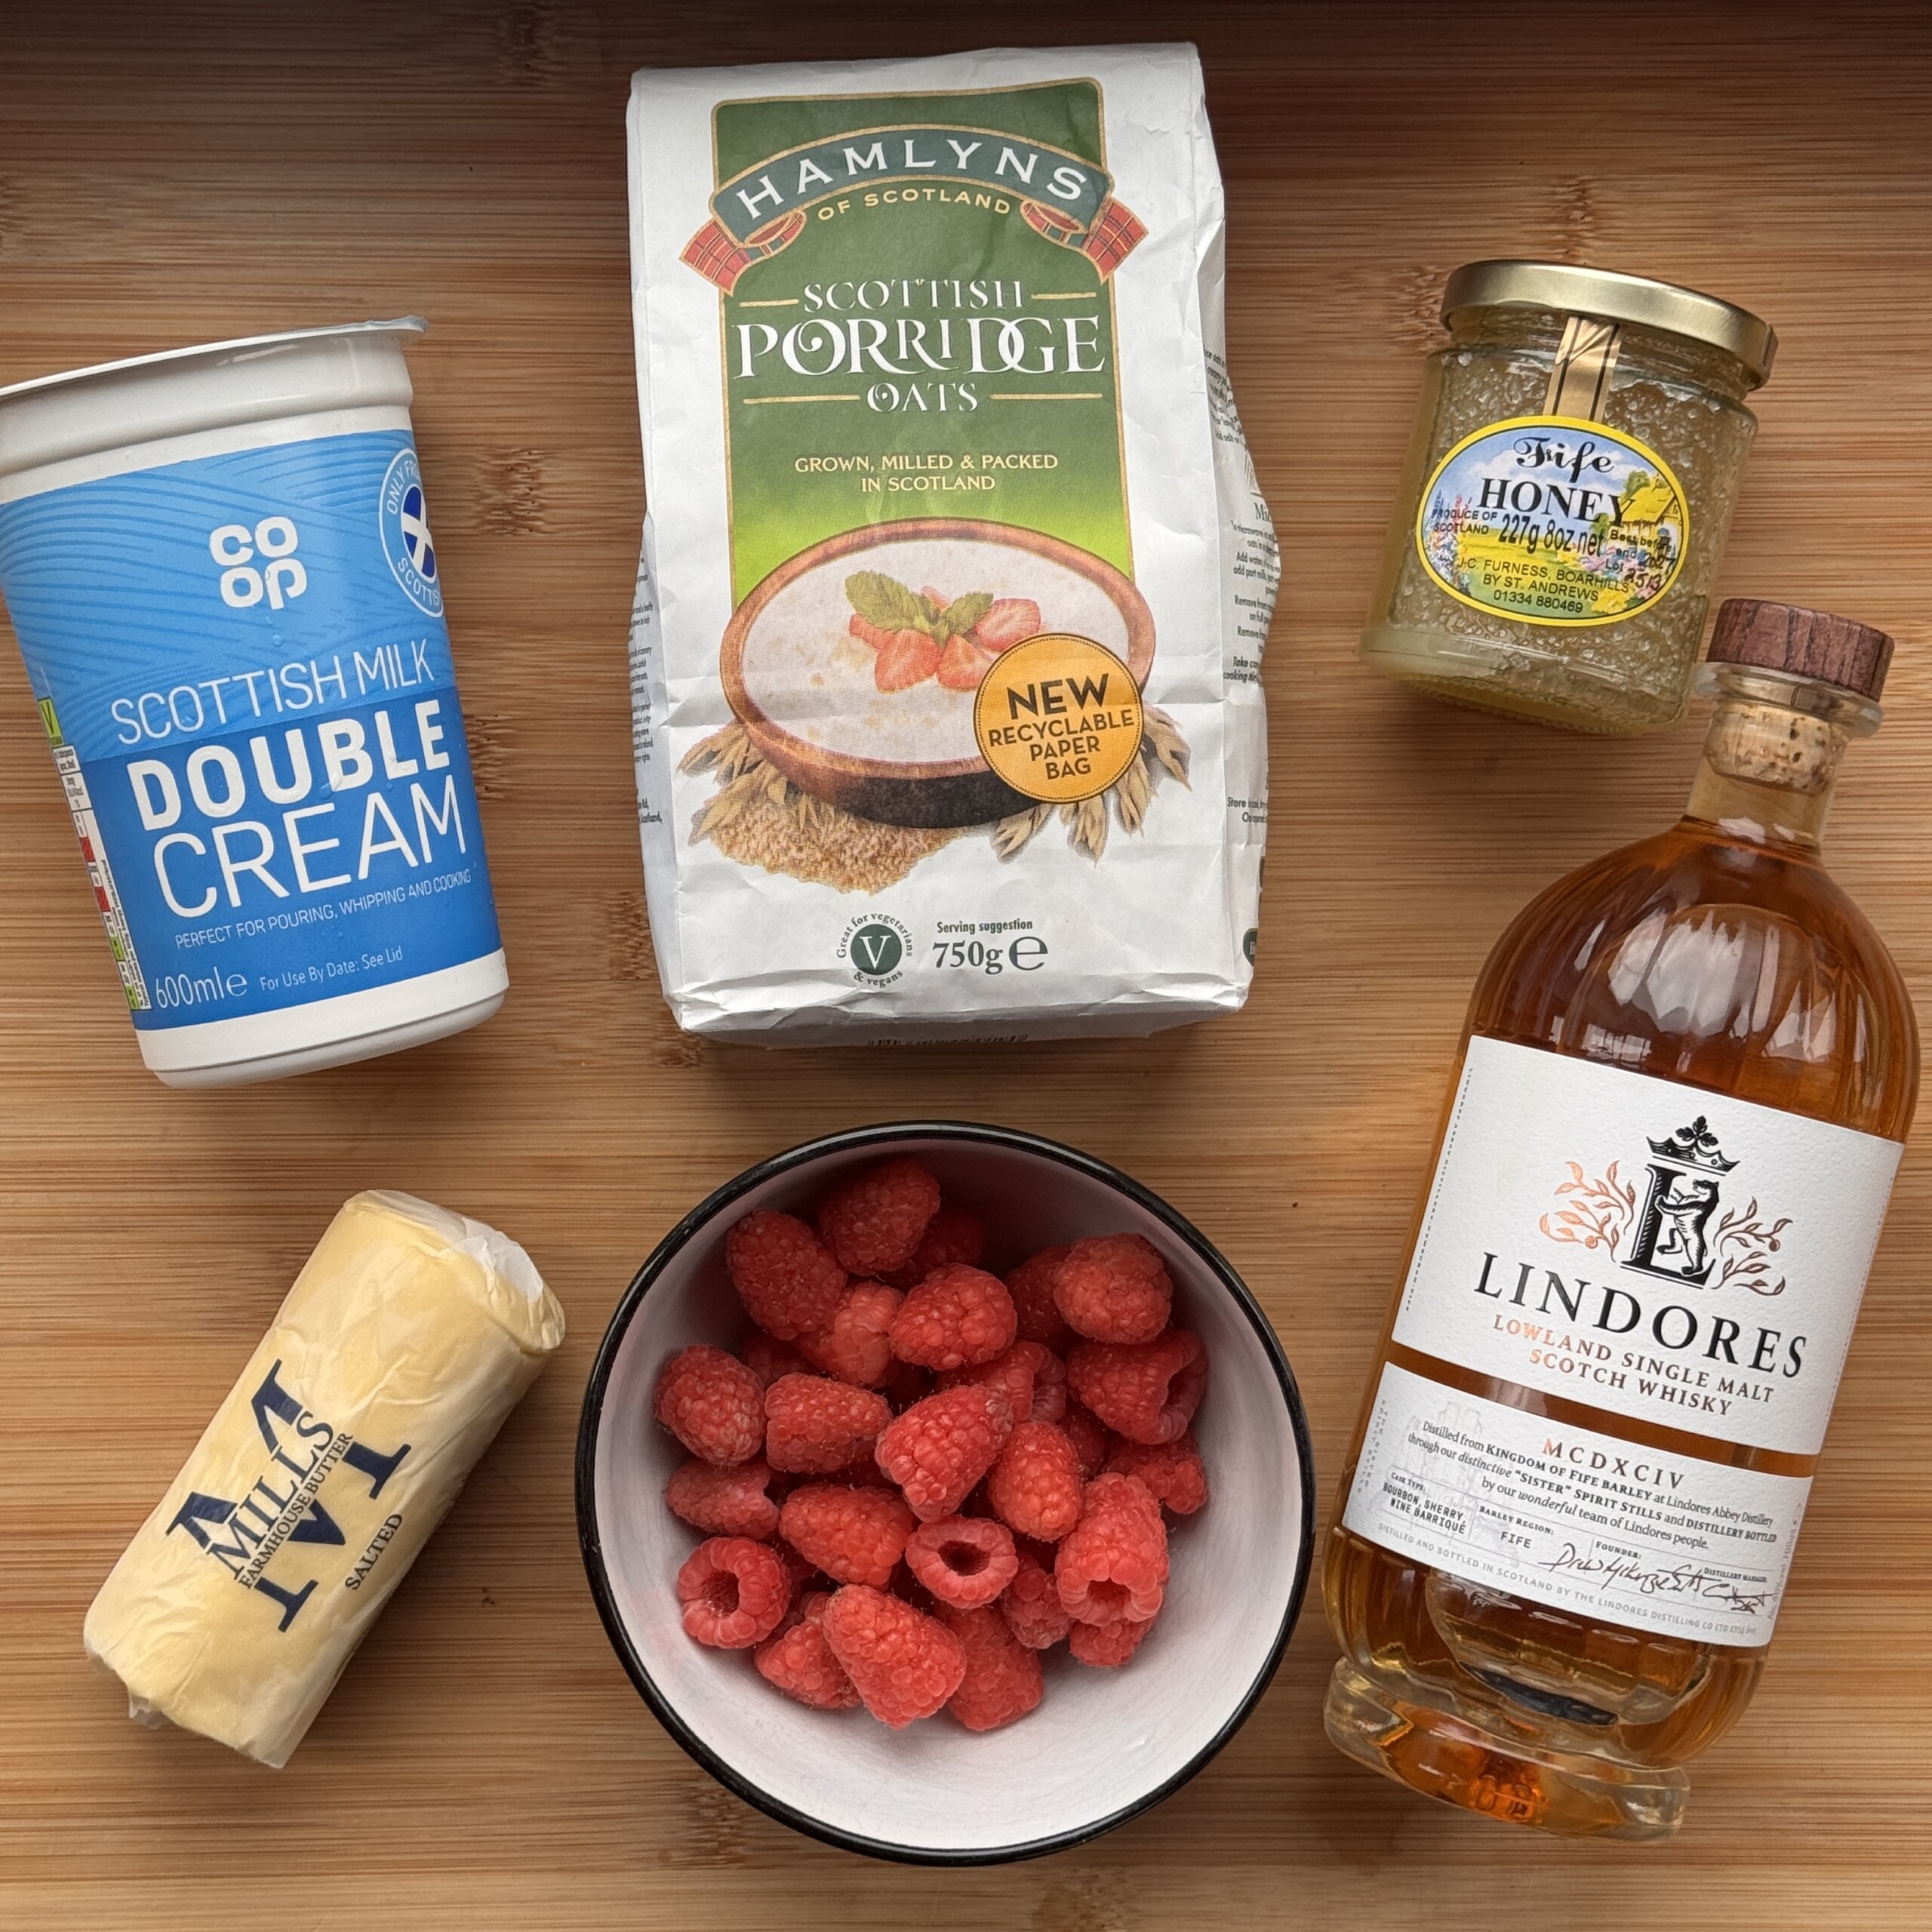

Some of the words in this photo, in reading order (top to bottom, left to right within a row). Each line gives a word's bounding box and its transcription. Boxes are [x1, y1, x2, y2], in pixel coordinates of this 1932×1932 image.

[736, 139, 1089, 220] HAMLYNS
[817, 200, 851, 221] OF
[864, 189, 1011, 215] SCOTLAND
[803, 278, 1024, 312] SCOTTISH
[733, 315, 1106, 379] PORRIDGE
[866, 382, 980, 413] OATS
[795, 456, 874, 474] GROWN,
[881, 454, 953, 470] MILLED
[960, 454, 974, 469] &
[981, 454, 1058, 470] PACKED
[1513, 435, 1615, 483] Fife
[386, 466, 405, 515] ONLY
[405, 460, 420, 481] FRO
[861, 476, 881, 492] IN
[887, 475, 996, 492] SCOTLAND
[1477, 477, 1636, 528] HONEY
[1432, 508, 1479, 521] PRODUCE
[1482, 510, 1497, 521] OF
[1434, 522, 1489, 535] SCOTLAND
[1498, 513, 1540, 554] 227g
[1543, 523, 1574, 552] 8oz
[1575, 528, 1605, 558] net
[1610, 529, 1638, 543] Best
[1616, 548, 1637, 558] end
[1483, 559, 1550, 580] FURNESS,
[1556, 569, 1630, 593] BOARHILLS
[1606, 558, 1624, 572] Lot
[1482, 574, 1500, 586] BY
[1504, 577, 1525, 590] ST.
[1528, 580, 1599, 602] ANDREWS
[1494, 589, 1532, 605] 01334
[1536, 593, 1583, 614] 880469
[1223, 669, 1247, 684] cooking
[1233, 656, 1248, 668] Take
[111, 655, 346, 745] SCOTTISH
[354, 638, 435, 695] MILK
[1007, 672, 1109, 720] NEW
[988, 709, 1134, 747] RECYCLABLE
[127, 700, 450, 831] DOUBLE
[1029, 735, 1101, 761] PAPER
[1045, 758, 1091, 780] BAG
[1227, 797, 1246, 808] Store
[153, 774, 466, 918] CREAM
[175, 926, 232, 950] PERFECT
[236, 919, 266, 939] FOR
[269, 904, 338, 930] POURING,
[339, 887, 406, 915] WHIPPING
[408, 879, 432, 899] AND
[433, 869, 472, 894] COOKING
[937, 921, 975, 934] Serving
[978, 918, 1033, 934] suggestion
[836, 926, 853, 958] Great
[851, 914, 869, 928] for
[870, 913, 912, 957] vegetarians
[859, 934, 892, 971] V
[260, 976, 279, 992] For
[282, 971, 305, 987] Use
[309, 966, 325, 984] By
[327, 958, 358, 980] Date:
[361, 952, 383, 970] See
[384, 946, 403, 964] Lid
[933, 940, 1003, 974] 750g
[853, 971, 863, 983] &
[867, 970, 903, 988] vegans
[1474, 1251, 1807, 1380] LINDORES
[1493, 1313, 1612, 1361] LOWLAND
[1621, 1352, 1710, 1389] SINGLE
[1717, 1377, 1775, 1404] MALT
[1528, 1348, 1628, 1390] SCOTCH
[1638, 1379, 1734, 1417] WHISKY
[1408, 1432, 1440, 1455] through
[1440, 1446, 1457, 1460] our
[1458, 1451, 1512, 1478] distinctive
[1574, 1489, 1618, 1512] SPIRIT
[1620, 1501, 1662, 1521] STILLS
[1664, 1515, 1684, 1527] and
[1686, 1518, 1744, 1540] DISTILLERY
[1423, 1420, 1460, 1444] Distilled
[1460, 1435, 1484, 1452] from
[1486, 1443, 1546, 1472] KINGDOM
[1570, 1470, 1598, 1487] FIFE
[1601, 1479, 1653, 1501] BARLEY
[1654, 1494, 1666, 1504] at
[1666, 1496, 1711, 1515] Lindores
[1712, 1506, 1741, 1524] Abbey
[1741, 1512, 1774, 1528] Distillery
[206, 1410, 334, 1581] MILLS
[238, 1494, 311, 1589] FARMHOUSE
[306, 1432, 353, 1494] BUTTER
[1481, 1475, 1495, 1491] by
[1497, 1485, 1517, 1498] our
[1518, 1490, 1578, 1517] wonderful
[1579, 1509, 1607, 1526] team
[1610, 1516, 1624, 1529] of
[1624, 1519, 1672, 1542] Lindores
[1672, 1533, 1709, 1551] people.
[345, 1513, 403, 1591] SALTED
[1500, 1531, 1532, 1549] FIFE
[1378, 1522, 1414, 1544] DISTILLED
[1416, 1540, 1434, 1552] AND
[1437, 1547, 1479, 1568] BOTTLED
[1482, 1562, 1494, 1573] IN
[1497, 1567, 1553, 1592] SCOTLAND
[1556, 1586, 1571, 1596] BY
[1574, 1591, 1594, 1604] THE
[1598, 1597, 1648, 1617] LINDORES
[1651, 1611, 1700, 1629] DISTILLING
